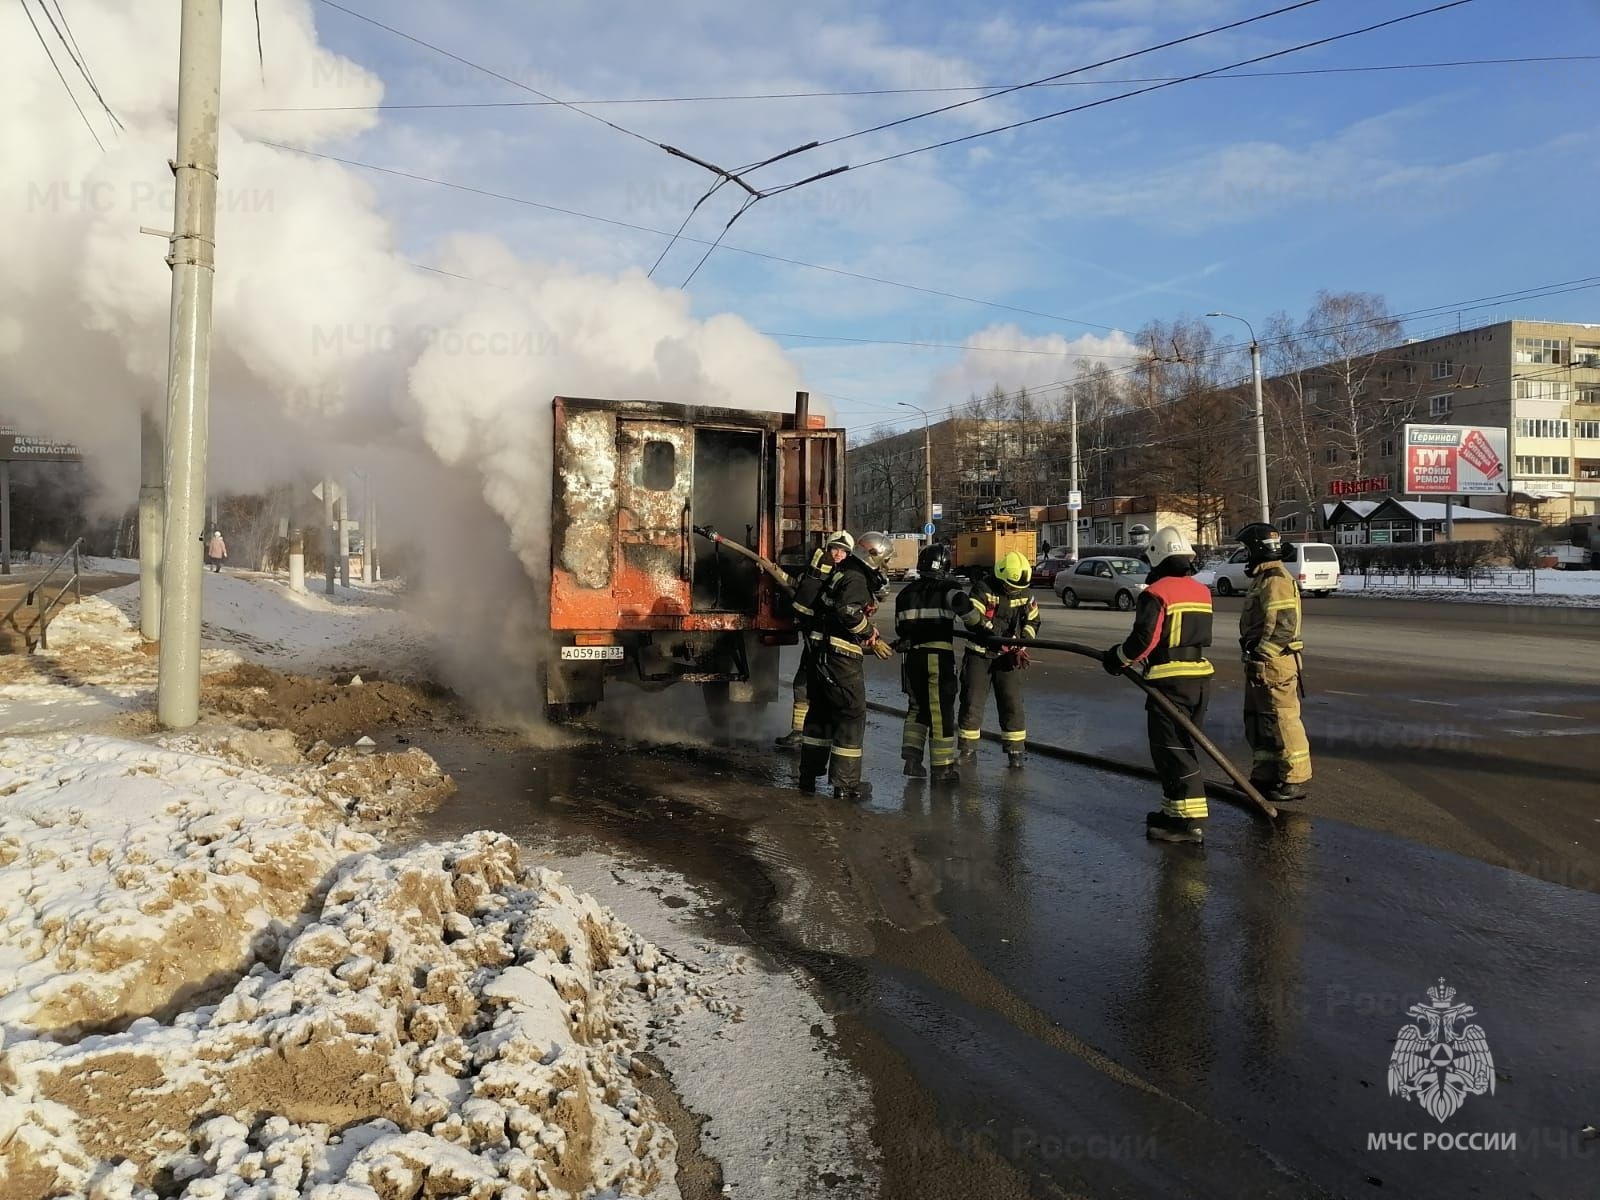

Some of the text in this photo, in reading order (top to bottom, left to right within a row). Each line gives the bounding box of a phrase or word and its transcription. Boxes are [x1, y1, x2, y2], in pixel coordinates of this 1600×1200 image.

[1413, 431, 1457, 443] Терминал
[1416, 449, 1449, 466] ТУТ
[1413, 466, 1452, 475] СТРОЙКА
[1415, 475, 1450, 484] РЕМОНТ
